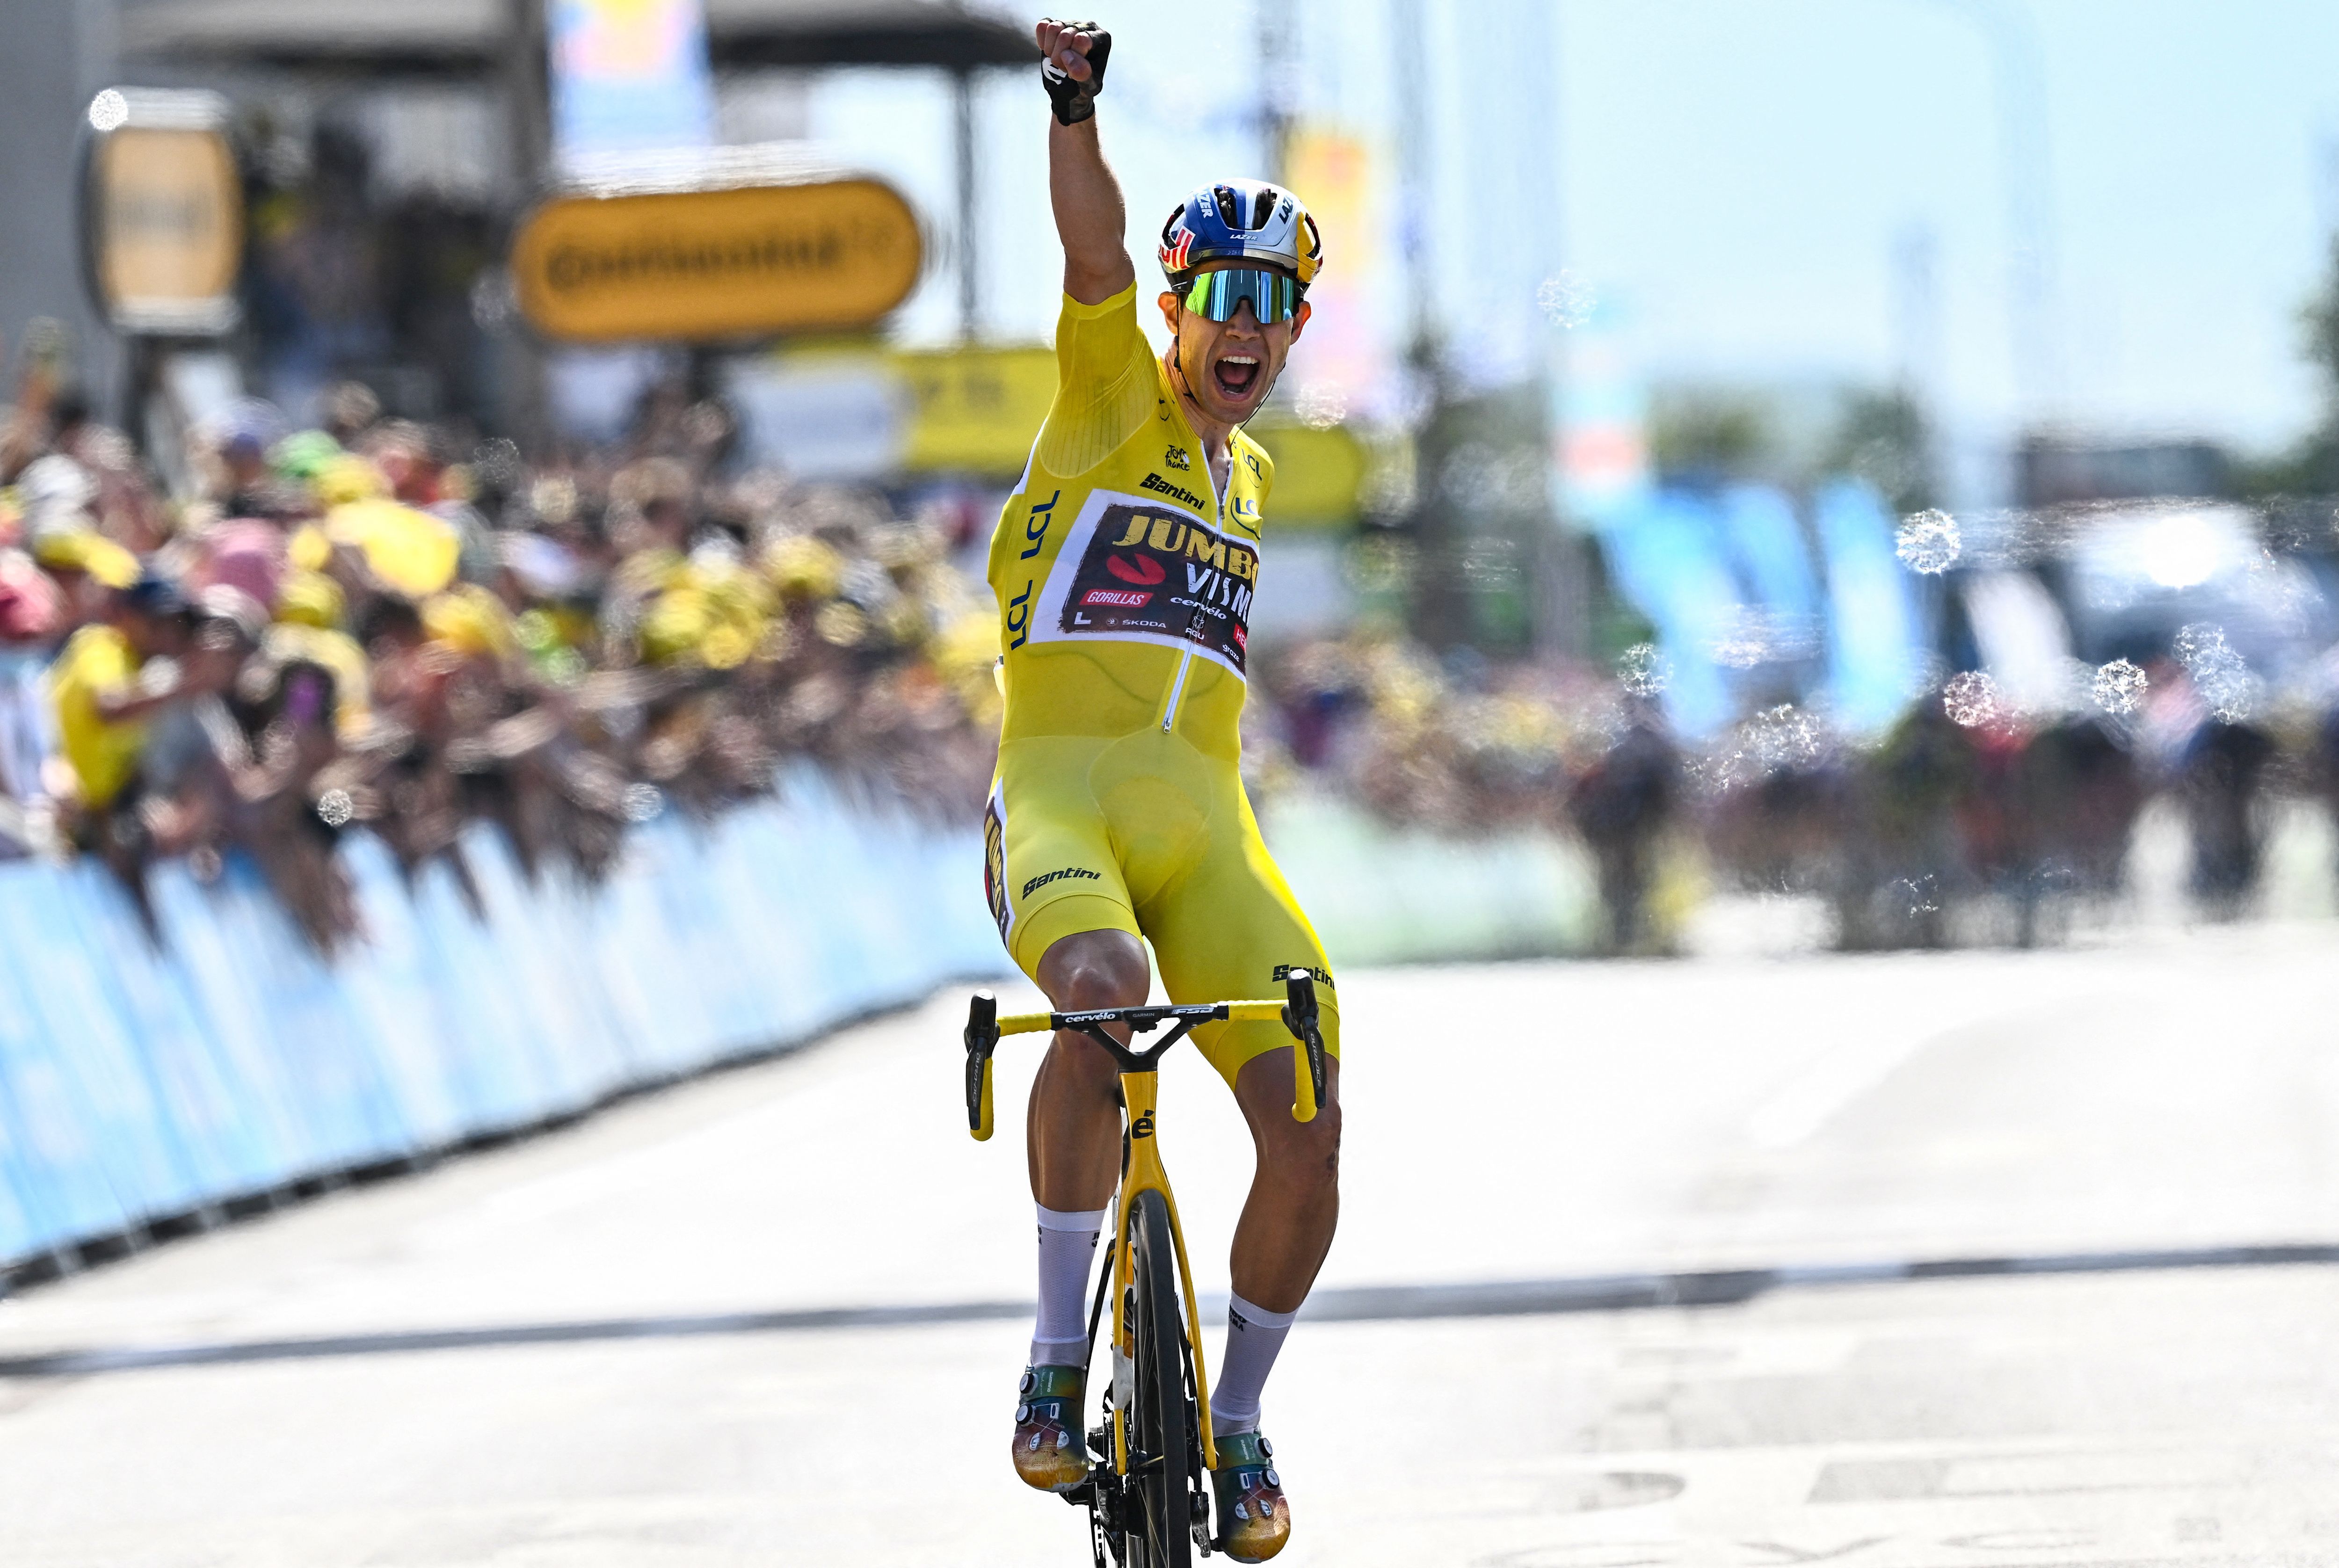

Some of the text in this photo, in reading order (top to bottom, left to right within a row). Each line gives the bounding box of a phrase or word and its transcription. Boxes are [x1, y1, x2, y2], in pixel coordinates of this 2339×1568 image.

[1196, 193, 1213, 218] ZER
[1278, 196, 1293, 225] LAZ
[1158, 228, 1193, 270] ull
[1241, 448, 1262, 481] LCL
[1139, 472, 1206, 510] Santini
[1235, 497, 1258, 515] LC
[1020, 490, 1060, 560] LCL
[1087, 591, 1145, 605] GORILLAS
[1170, 597, 1228, 620] cervélo
[1186, 562, 1252, 628] VISM
[1007, 580, 1033, 651] LCL
[1122, 619, 1167, 629] ŠKODA
[1185, 627, 1205, 640] AGU
[1222, 643, 1240, 662] graze
[1022, 867, 1102, 901] Santini
[1065, 1012, 1116, 1023] cervélo
[1310, 1033, 1322, 1087] DURA-ACE
[1131, 1109, 1155, 1140] é
